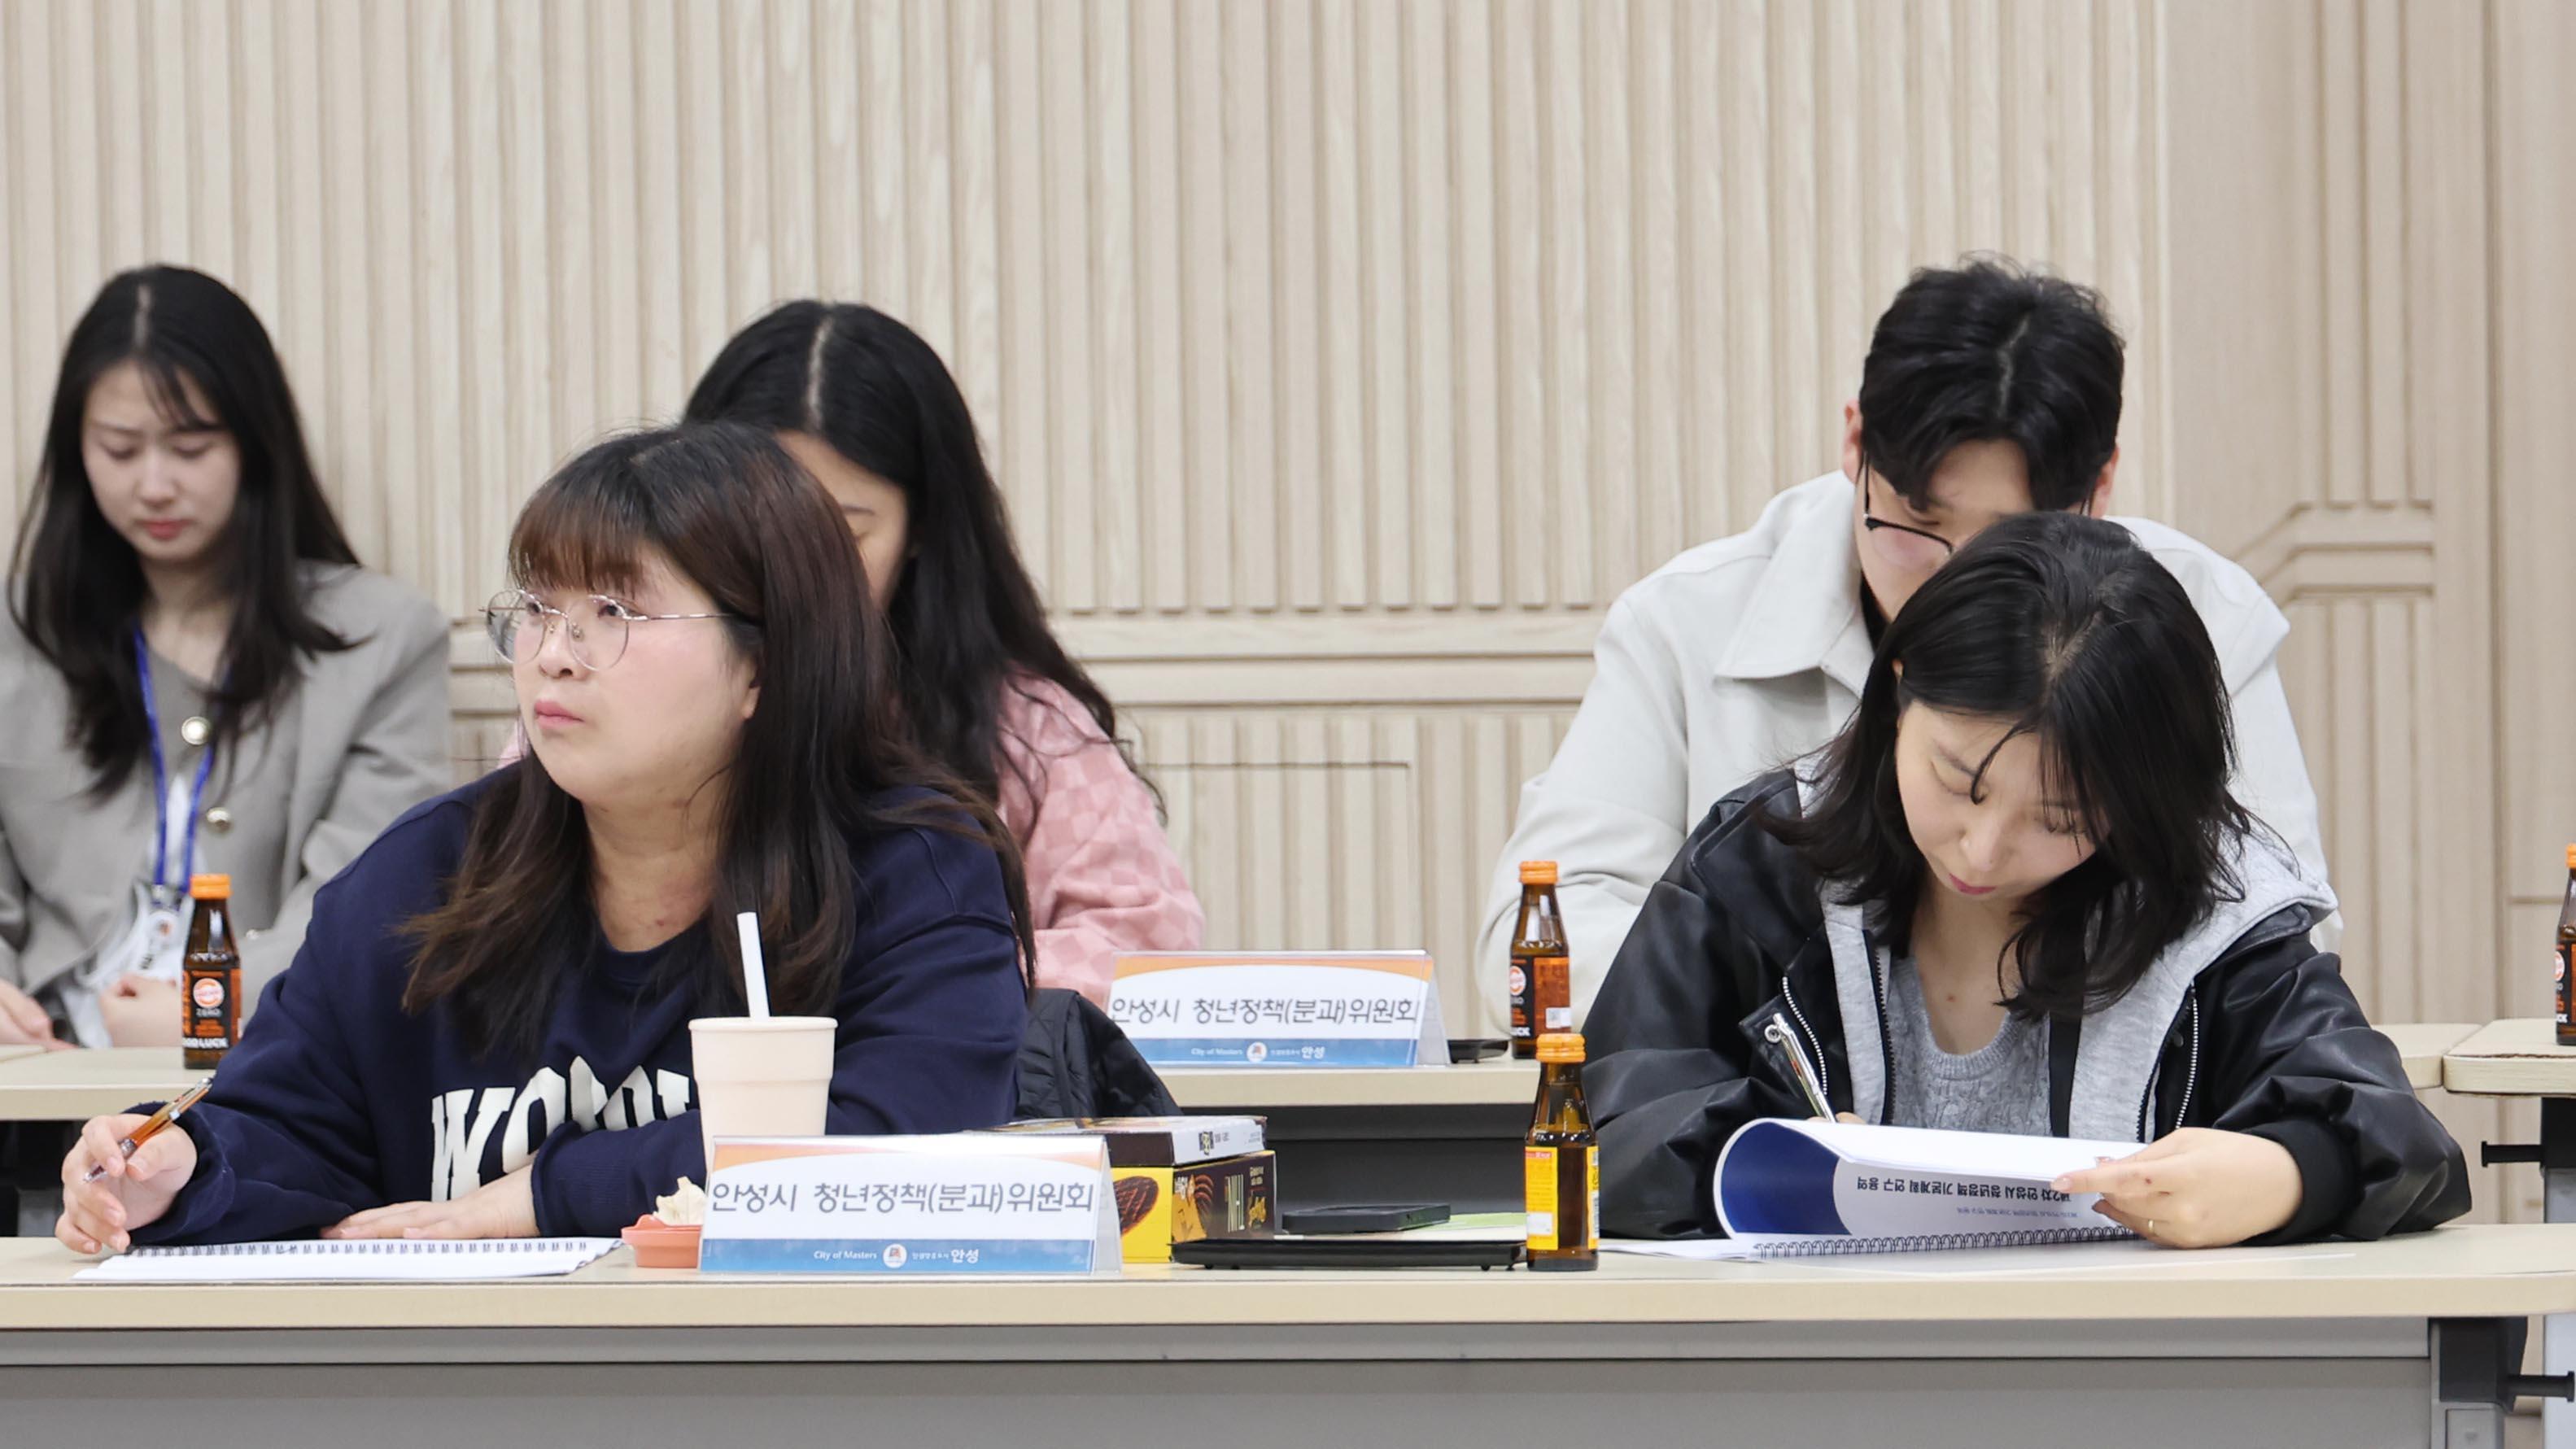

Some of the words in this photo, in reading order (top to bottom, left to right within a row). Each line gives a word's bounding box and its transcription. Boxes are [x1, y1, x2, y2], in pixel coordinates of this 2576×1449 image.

[1111, 997, 1181, 1024] 안성시
[1193, 997, 1420, 1025] 청년정책(분과)위원회
[1857, 1176, 1880, 1190] 용역
[1884, 1178, 1905, 1192] 연구
[1909, 1180, 1954, 1195] 기본계획
[1957, 1183, 2001, 1198] 청년정책
[712, 1182, 797, 1213] 안성시
[814, 1182, 1094, 1214] 청년정책(분과)위원회
[2005, 1186, 2038, 1200] 안성시
[813, 1250, 831, 1261] City
[832, 1250, 842, 1259] of
[843, 1250, 878, 1260] Masters
[950, 1249, 980, 1264] 안성
